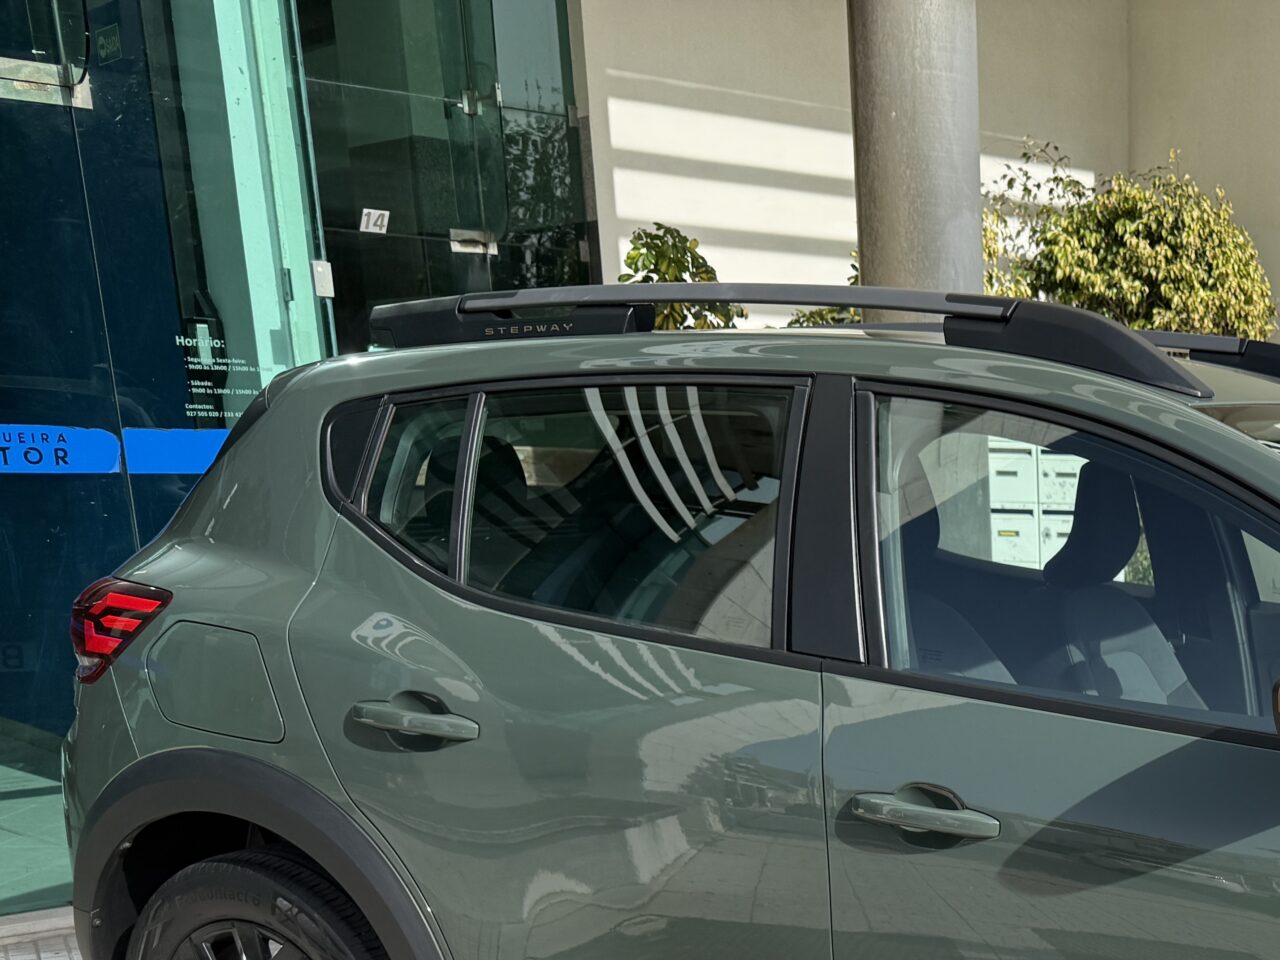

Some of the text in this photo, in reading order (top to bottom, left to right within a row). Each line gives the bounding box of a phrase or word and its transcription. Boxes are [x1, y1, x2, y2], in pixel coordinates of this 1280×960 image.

[365, 211, 386, 232] 14
[484, 323, 573, 336] STEPWAY
[0, 446, 69, 466] TOR
